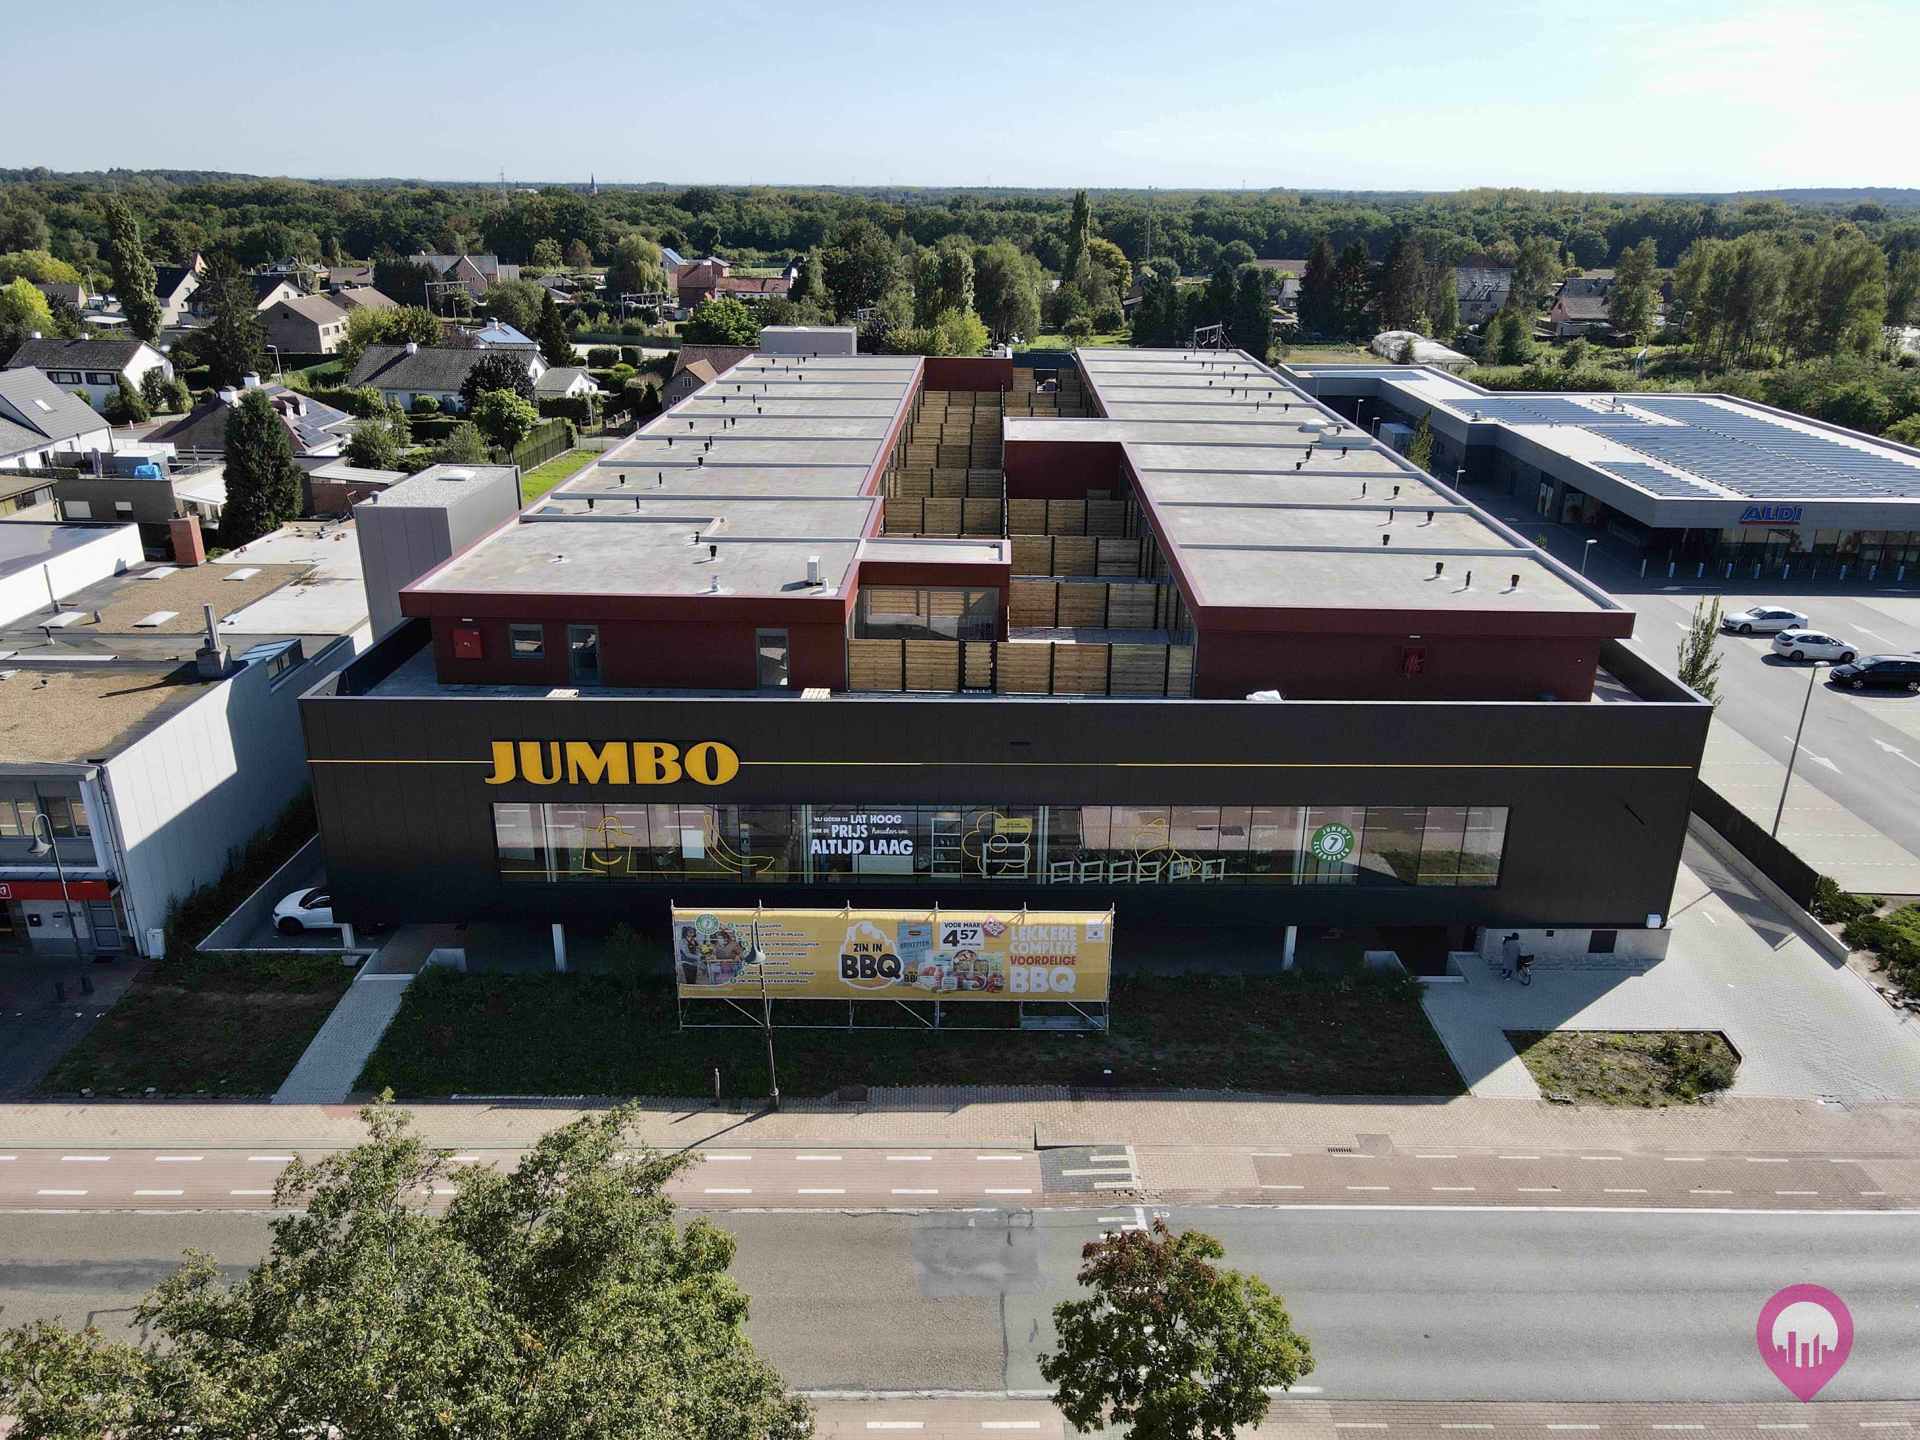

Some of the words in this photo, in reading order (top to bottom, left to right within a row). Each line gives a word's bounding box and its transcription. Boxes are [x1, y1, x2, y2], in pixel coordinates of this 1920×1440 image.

[1741, 505, 1803, 521] ALDI
[485, 741, 740, 785] JUMBO
[850, 815, 868, 824] LAT
[870, 815, 902, 824] HOOG
[832, 825, 868, 838] PRIJS
[811, 840, 865, 854] ALTIJD
[870, 839, 913, 854] LAAG
[1329, 837, 1339, 850] 7
[853, 943, 868, 953] ZIN
[872, 943, 883, 953] IN
[841, 953, 902, 979] BBQ
[1010, 955, 1077, 966] VOORDELIGE
[1010, 966, 1077, 993] BBQ
